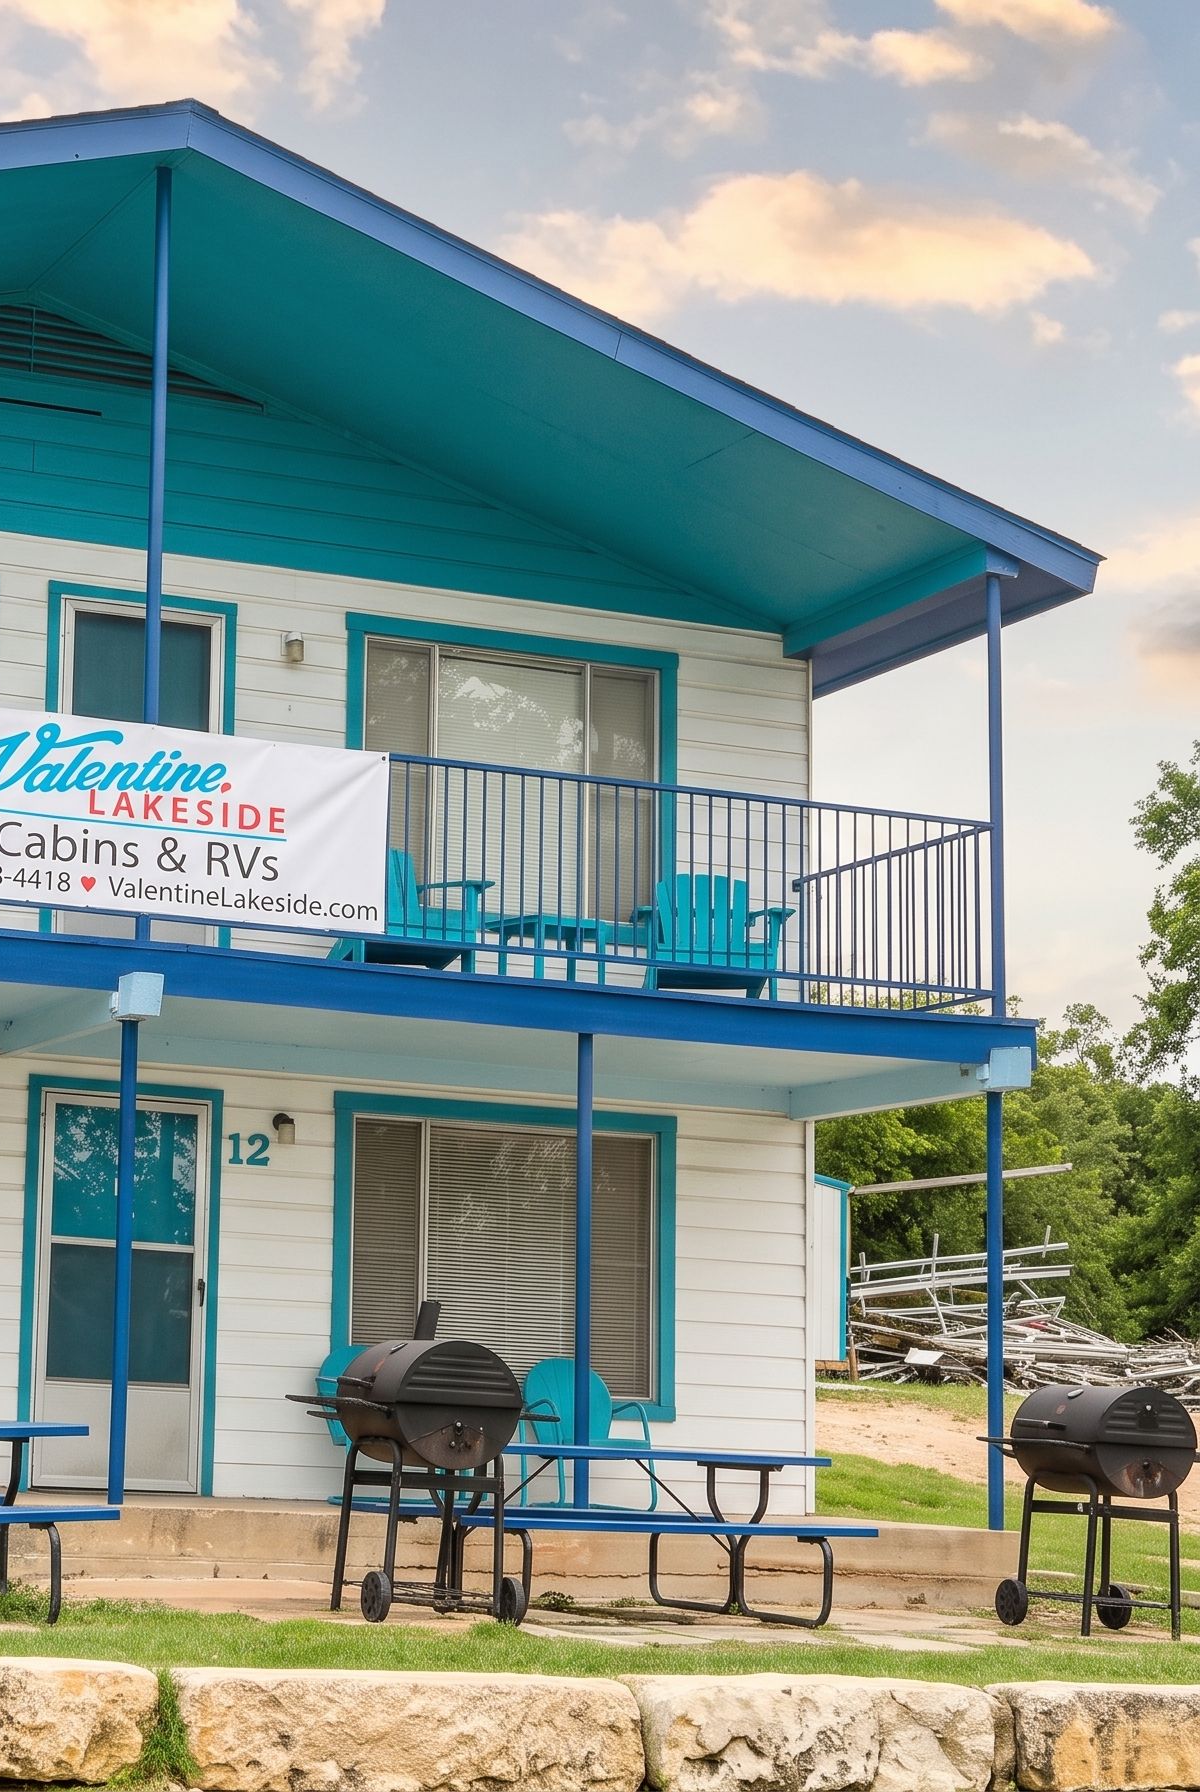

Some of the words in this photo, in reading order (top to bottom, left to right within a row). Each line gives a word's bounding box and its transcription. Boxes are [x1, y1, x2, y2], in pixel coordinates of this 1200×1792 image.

[88, 789, 286, 834] LAKESIDE
[156, 836, 187, 874] &
[206, 841, 280, 882] RVs
[108, 875, 378, 921] ValentineLakeside.com
[228, 1132, 270, 1166] 12
